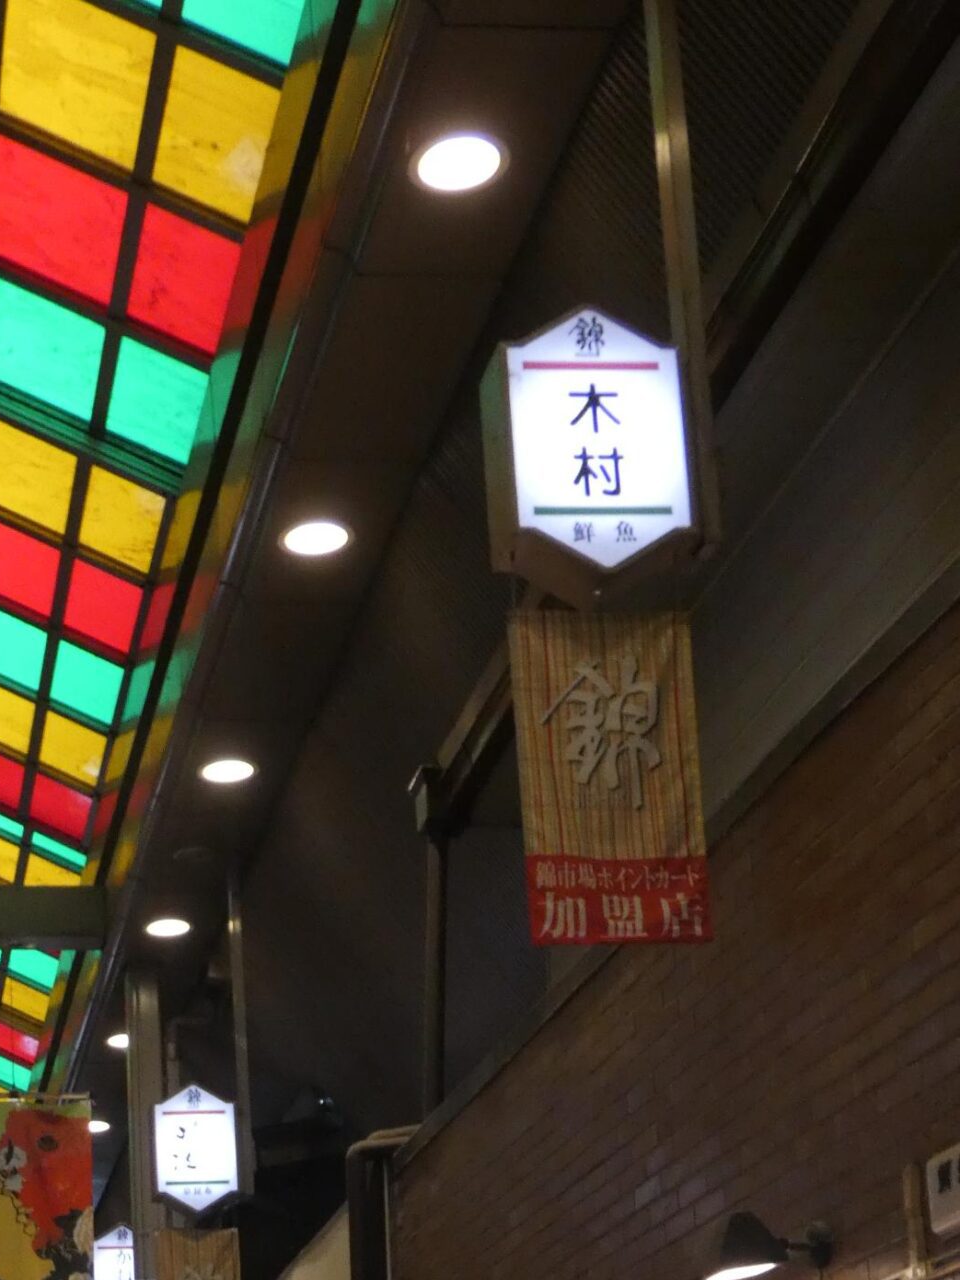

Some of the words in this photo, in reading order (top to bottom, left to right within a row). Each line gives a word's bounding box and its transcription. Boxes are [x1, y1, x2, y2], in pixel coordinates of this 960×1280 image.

[568, 383, 624, 496] 木村
[572, 520, 638, 543] 鮮魚
[540, 652, 664, 812] 錦
[538, 891, 705, 939] 加盟店
